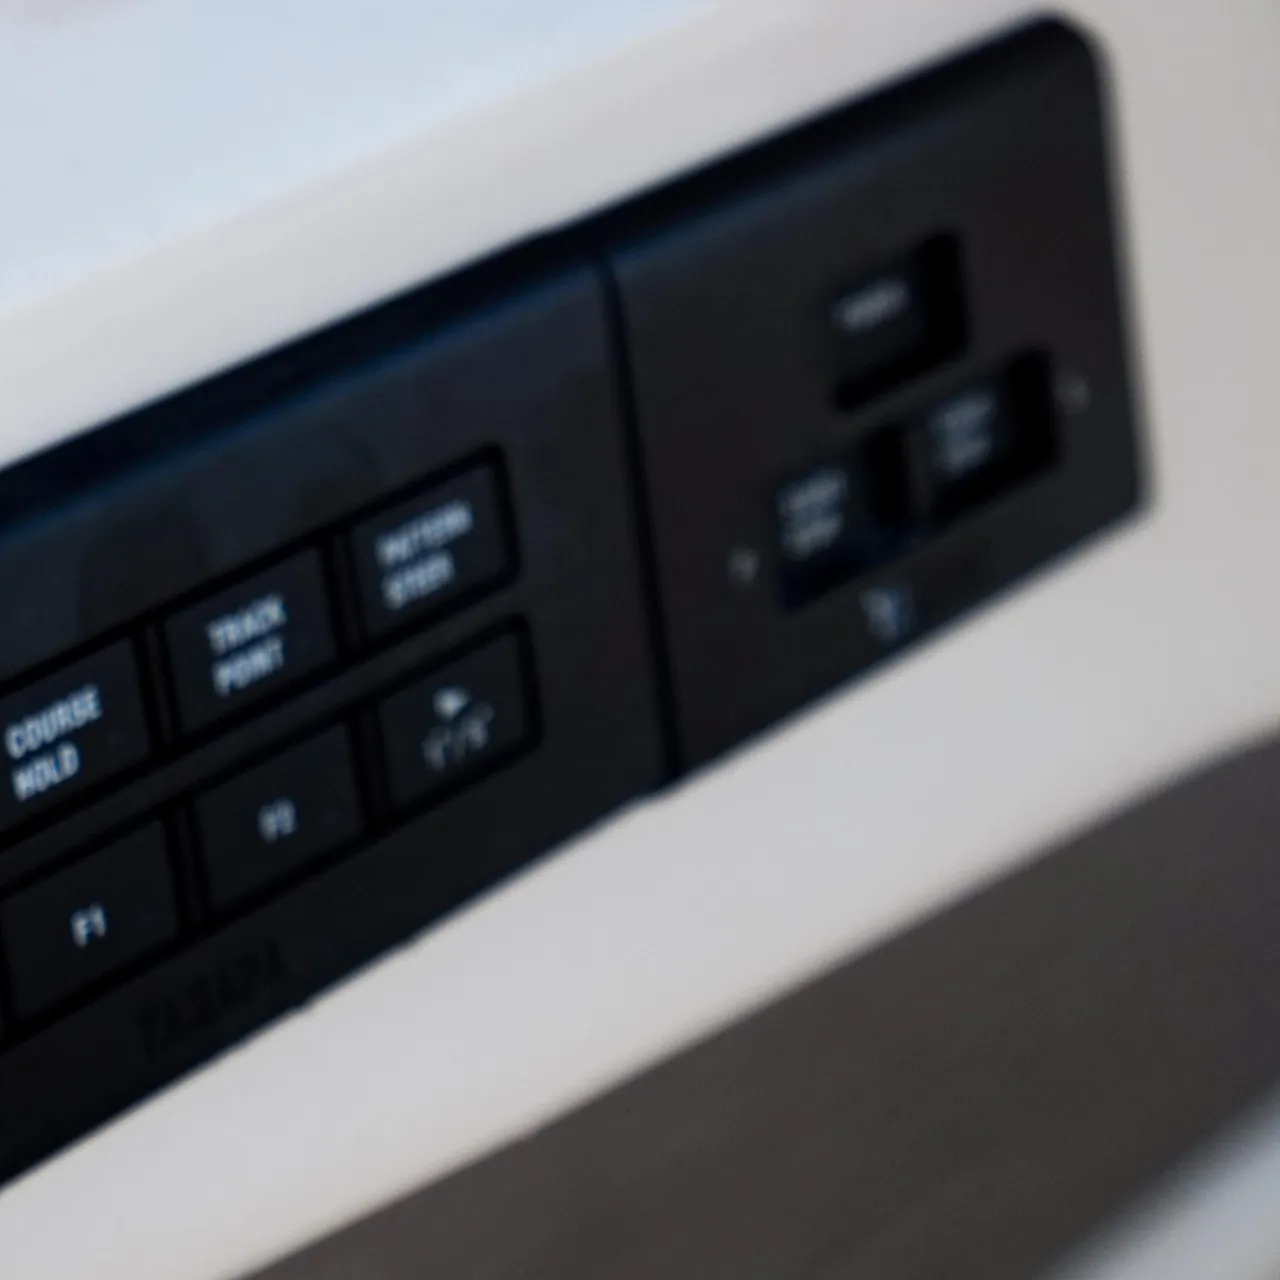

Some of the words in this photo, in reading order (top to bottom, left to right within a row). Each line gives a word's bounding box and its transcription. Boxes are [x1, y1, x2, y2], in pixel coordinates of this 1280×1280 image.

[207, 593, 287, 656] TRACK
[212, 634, 284, 697] POINT
[5, 683, 102, 759] COURSE
[12, 741, 80, 802] HOLD
[257, 796, 298, 844] F2
[71, 903, 107, 948] F1
